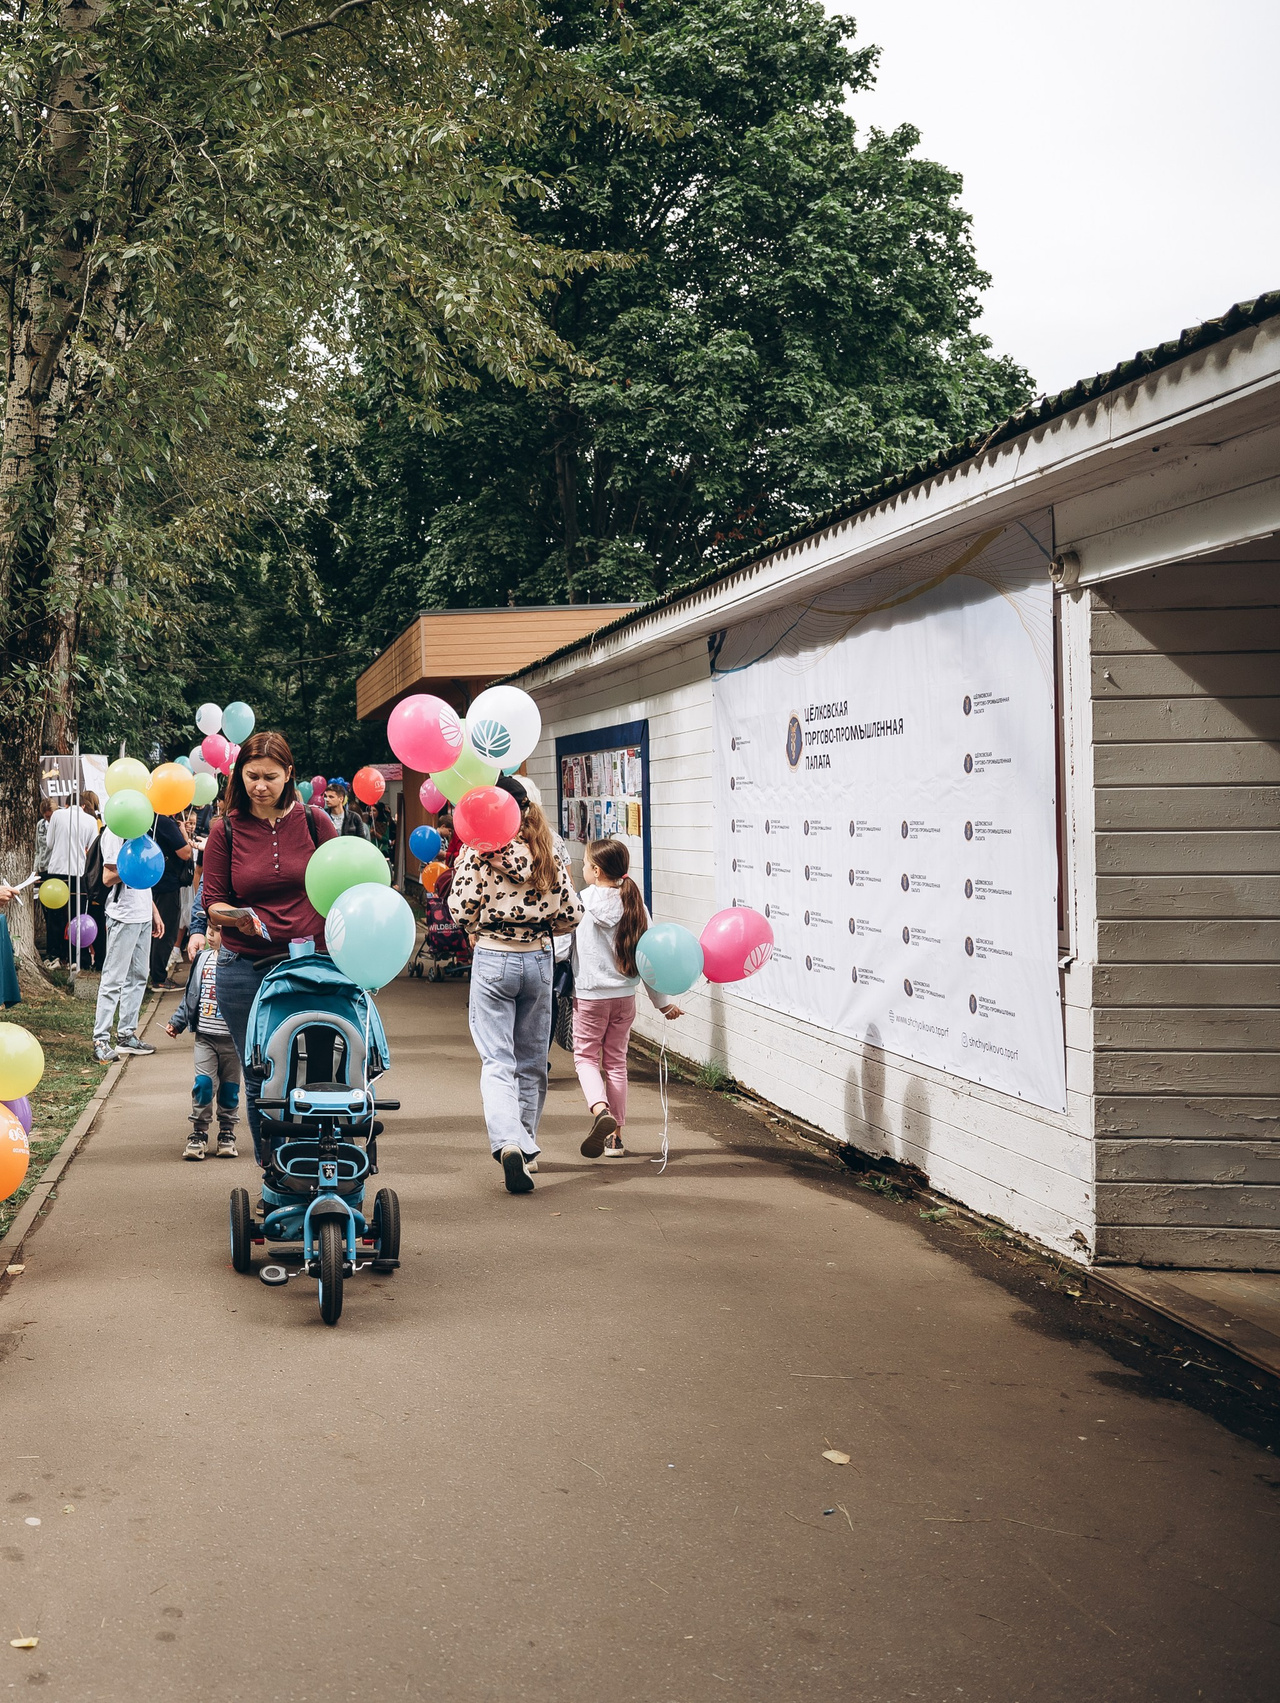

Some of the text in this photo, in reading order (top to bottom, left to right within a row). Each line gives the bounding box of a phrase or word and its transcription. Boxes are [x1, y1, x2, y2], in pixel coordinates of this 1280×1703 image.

[804, 718, 904, 746] ТОРГОВО-ПРОМЫШЛЕННАЯ
[805, 754, 831, 770] ПАЛАТА
[429, 923, 458, 931] WILDBER
